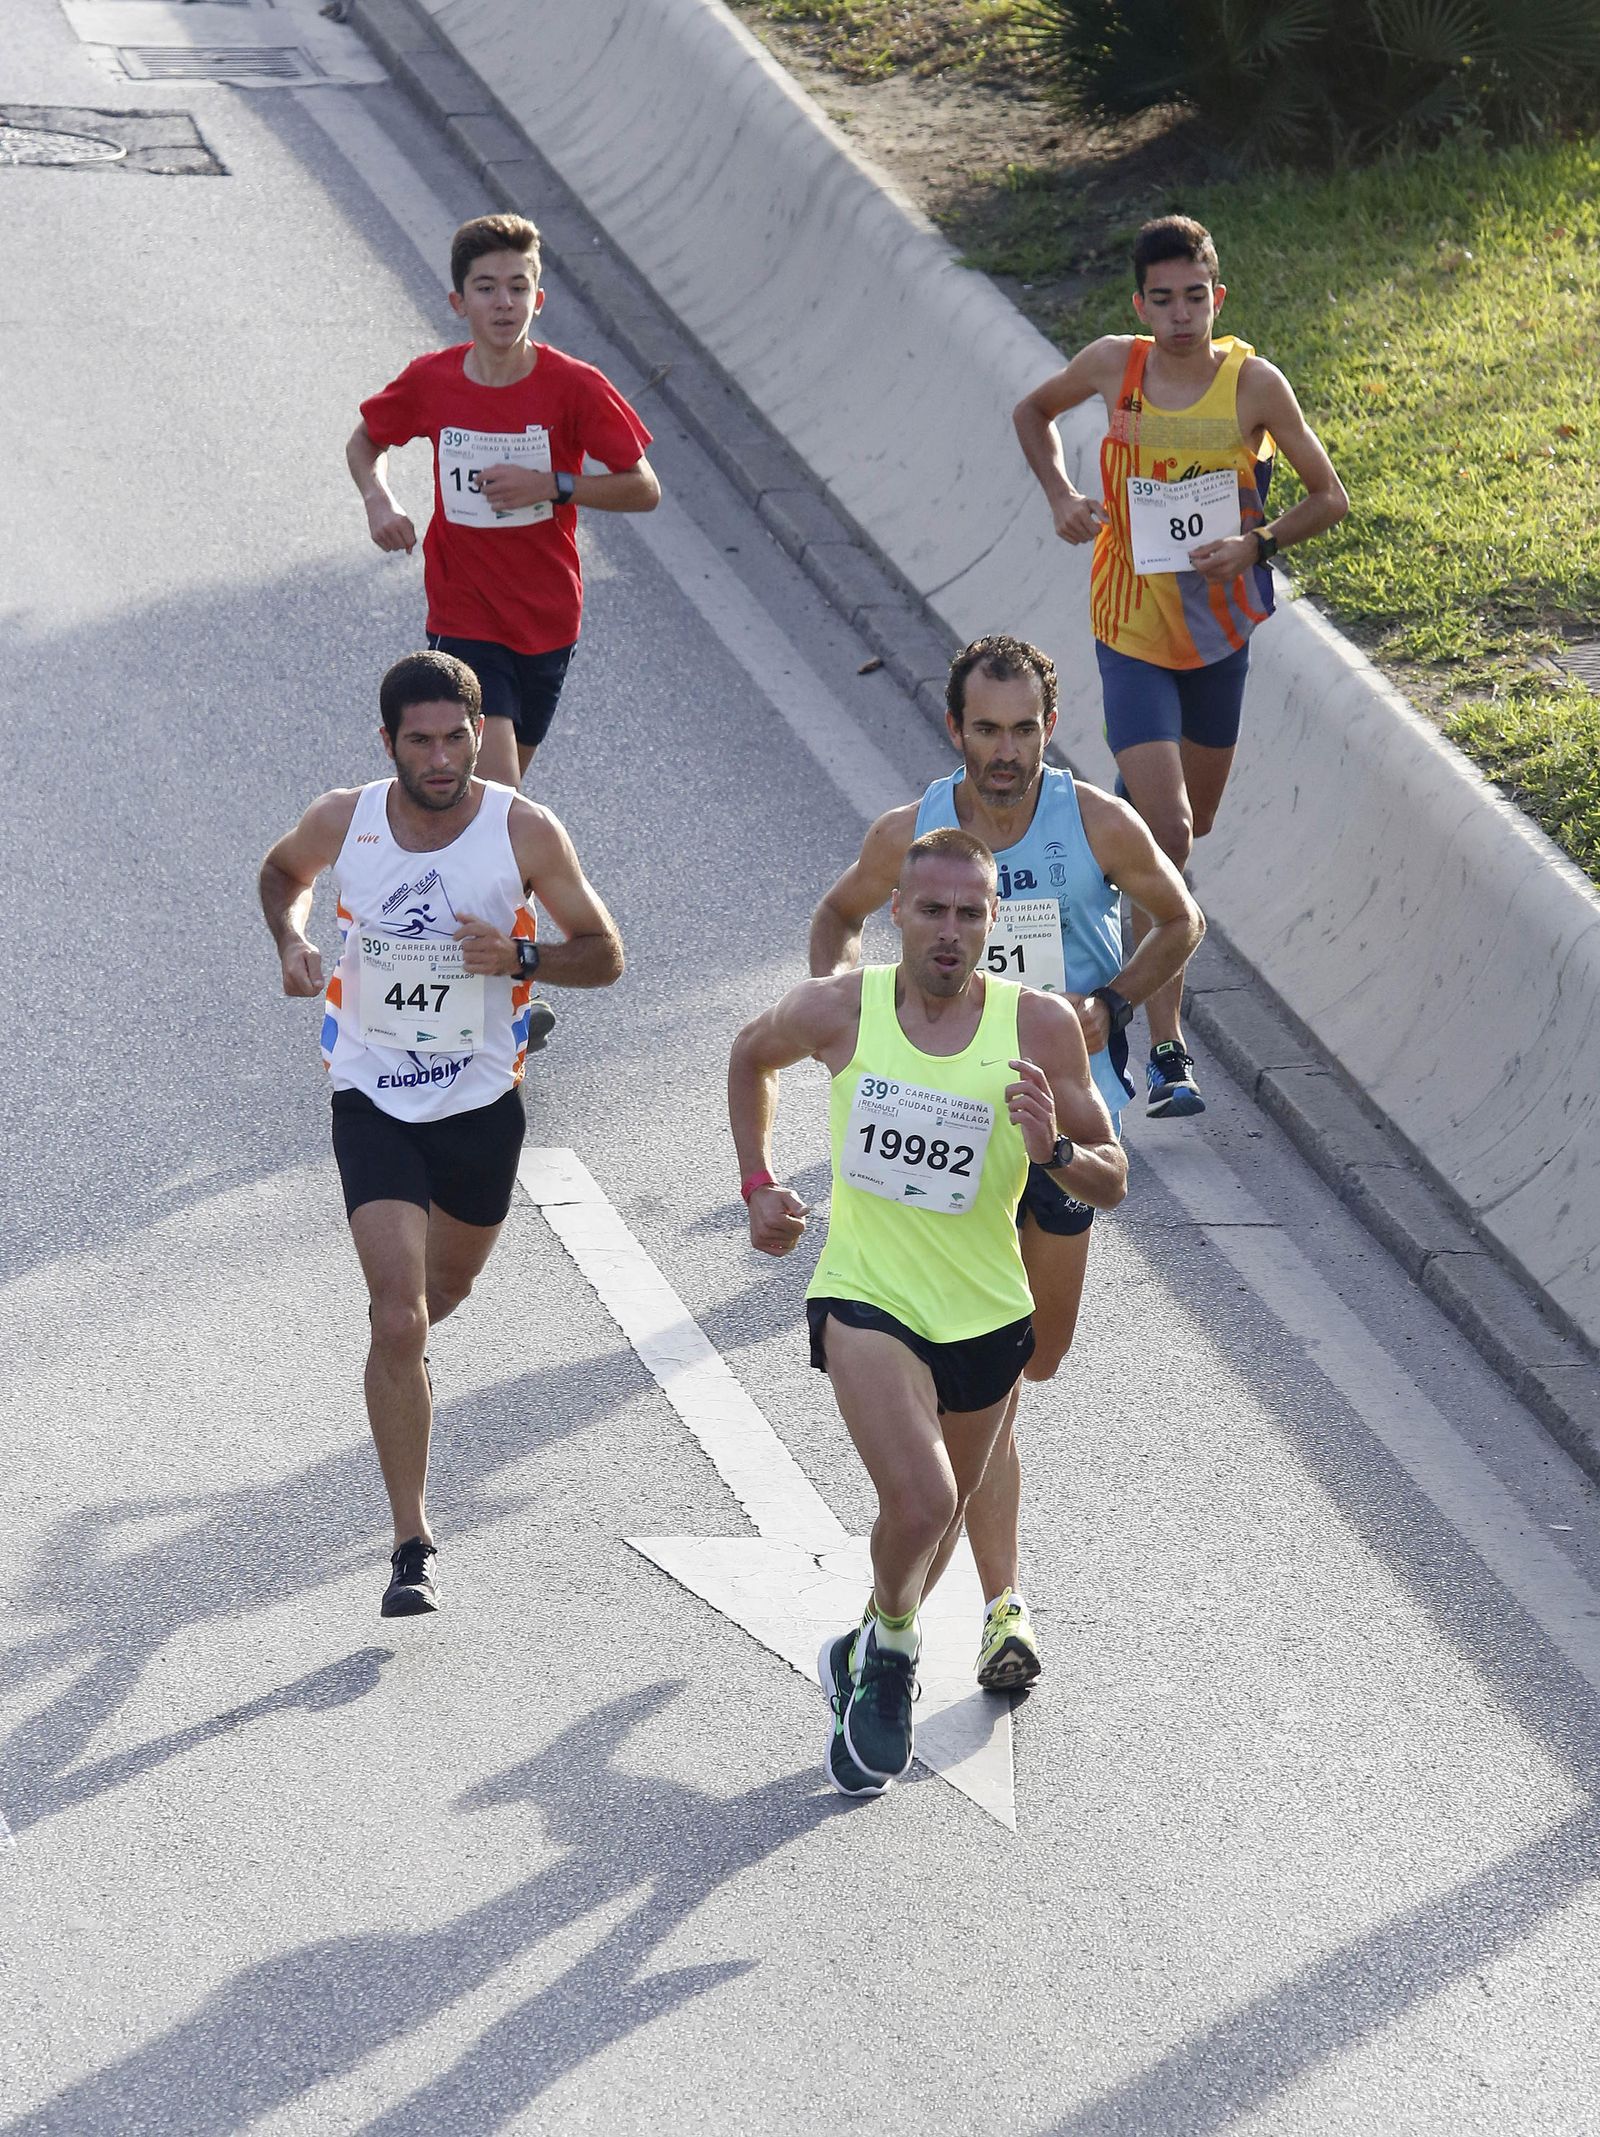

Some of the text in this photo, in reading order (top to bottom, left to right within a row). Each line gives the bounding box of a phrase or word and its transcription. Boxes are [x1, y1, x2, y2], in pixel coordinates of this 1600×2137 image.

[1169, 513, 1204, 541] 80
[357, 832, 380, 844] vive
[381, 869, 437, 912] ALBERO TEAM
[1014, 903, 1052, 911] URBANA
[1014, 932, 1052, 940] FEDERADO
[395, 943, 437, 951] CARRERA
[440, 944, 464, 952] URBA
[391, 954, 425, 962] CIUDAD
[443, 953, 464, 962] MÁL
[976, 945, 1025, 973] 51
[384, 982, 450, 1013] 447
[862, 1100, 896, 1113] RENAULT
[905, 1088, 948, 1104] CARRERA
[951, 1099, 989, 1114] URBANA
[898, 1099, 990, 1125] CIUDAD DE MÁLAGA
[859, 1124, 975, 1177] 19982
[857, 1173, 884, 1186] RENAULT
